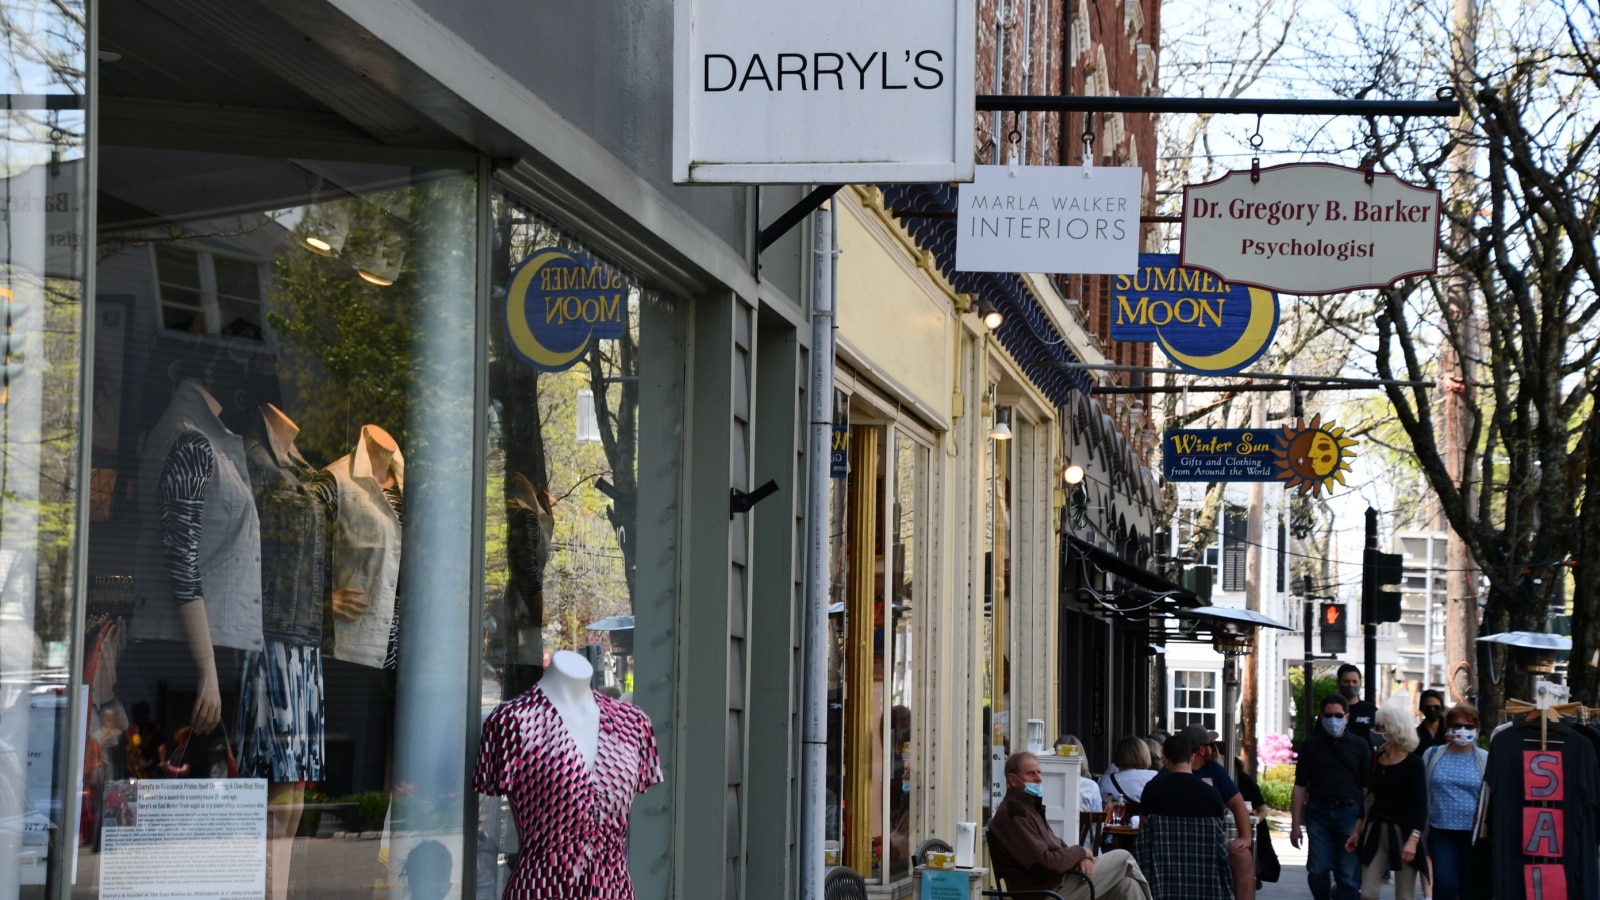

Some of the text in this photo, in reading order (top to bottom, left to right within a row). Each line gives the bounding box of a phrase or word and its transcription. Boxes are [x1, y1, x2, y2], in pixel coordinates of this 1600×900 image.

[704, 49, 944, 92] DARRYL'S
[971, 195, 1127, 212] MARLA WALKER
[1192, 197, 1431, 226] Dr. Gregory B. Barker
[971, 216, 1126, 241] INTERIORS
[1241, 238, 1376, 262] Psychologist
[1115, 295, 1226, 328] MOON
[1170, 432, 1271, 455] Winter Sun
[1171, 467, 1271, 477] from Around the World
[1180, 457, 1262, 467] Gifts and Clothing
